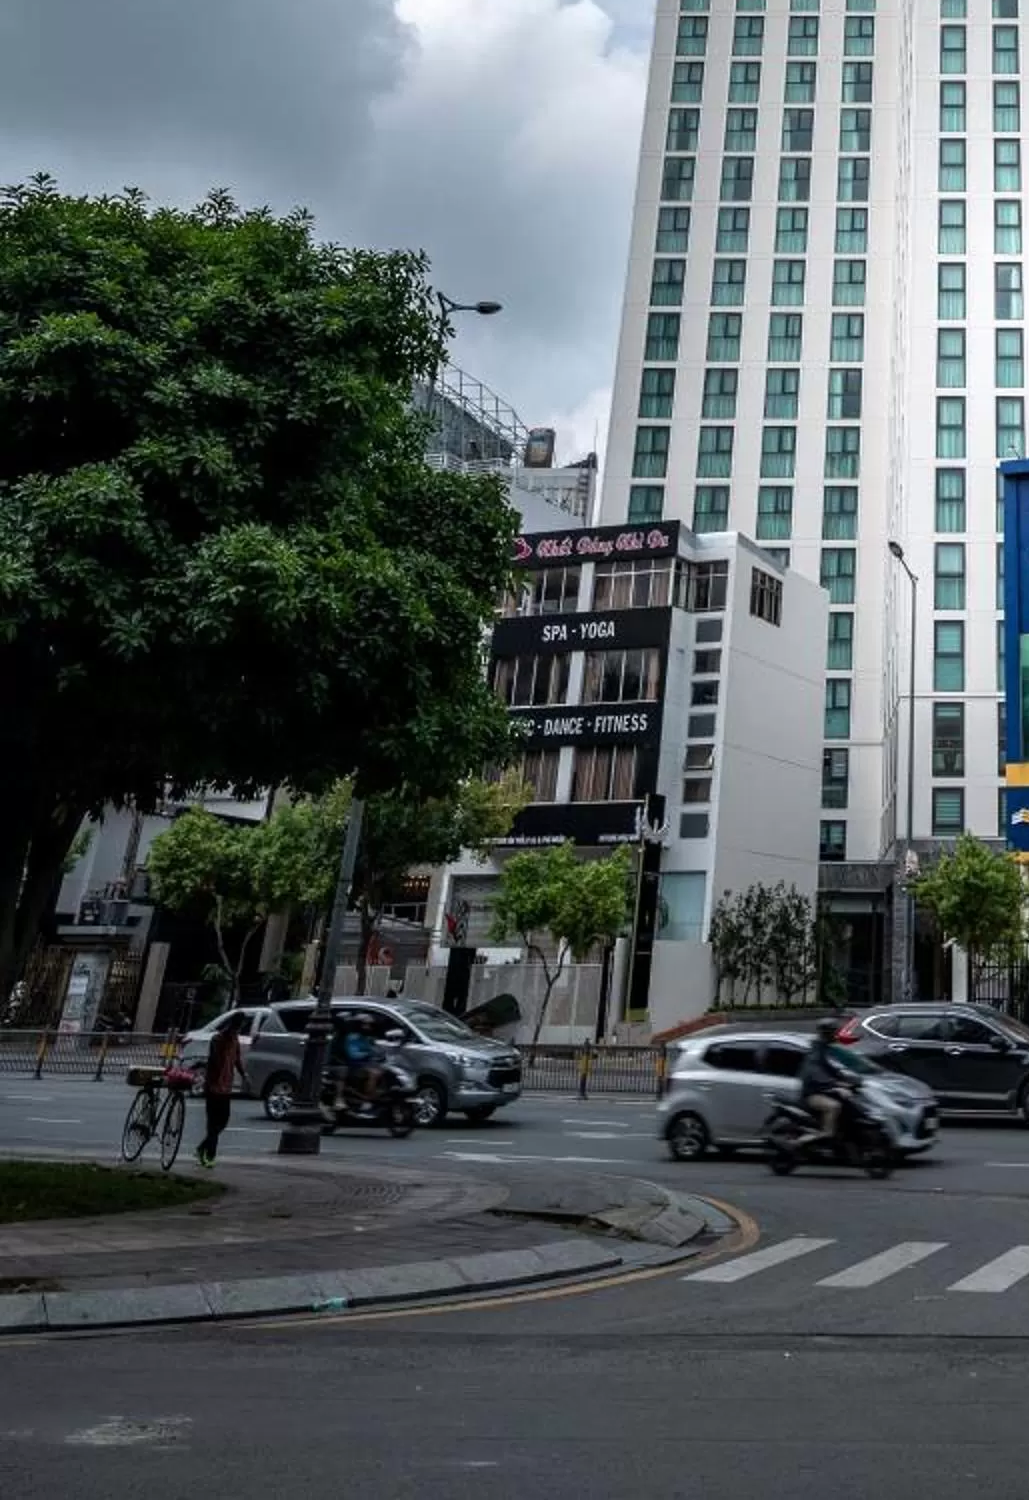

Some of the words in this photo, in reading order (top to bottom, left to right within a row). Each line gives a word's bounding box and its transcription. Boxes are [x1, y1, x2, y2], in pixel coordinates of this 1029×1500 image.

[541, 624, 567, 641] SPA
[580, 621, 615, 639] YOGA
[543, 717, 584, 736] DANCE
[593, 714, 648, 733] FITNESS
